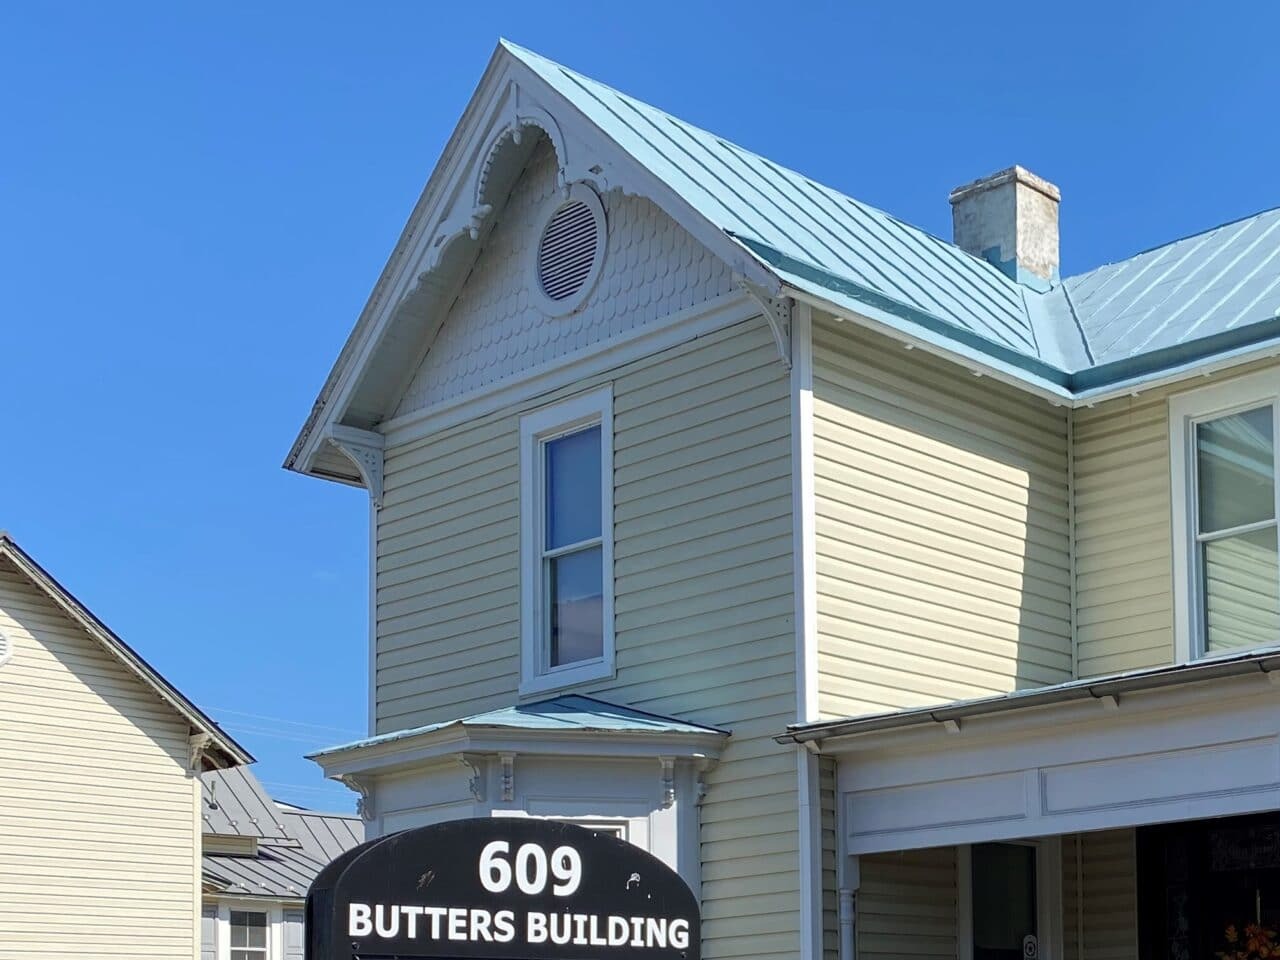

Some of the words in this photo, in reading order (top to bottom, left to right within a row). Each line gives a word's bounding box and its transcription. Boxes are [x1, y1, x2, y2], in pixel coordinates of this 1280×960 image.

[479, 840, 582, 897] 609
[349, 903, 515, 943] BUTTERS
[527, 911, 689, 949] BUILDING
